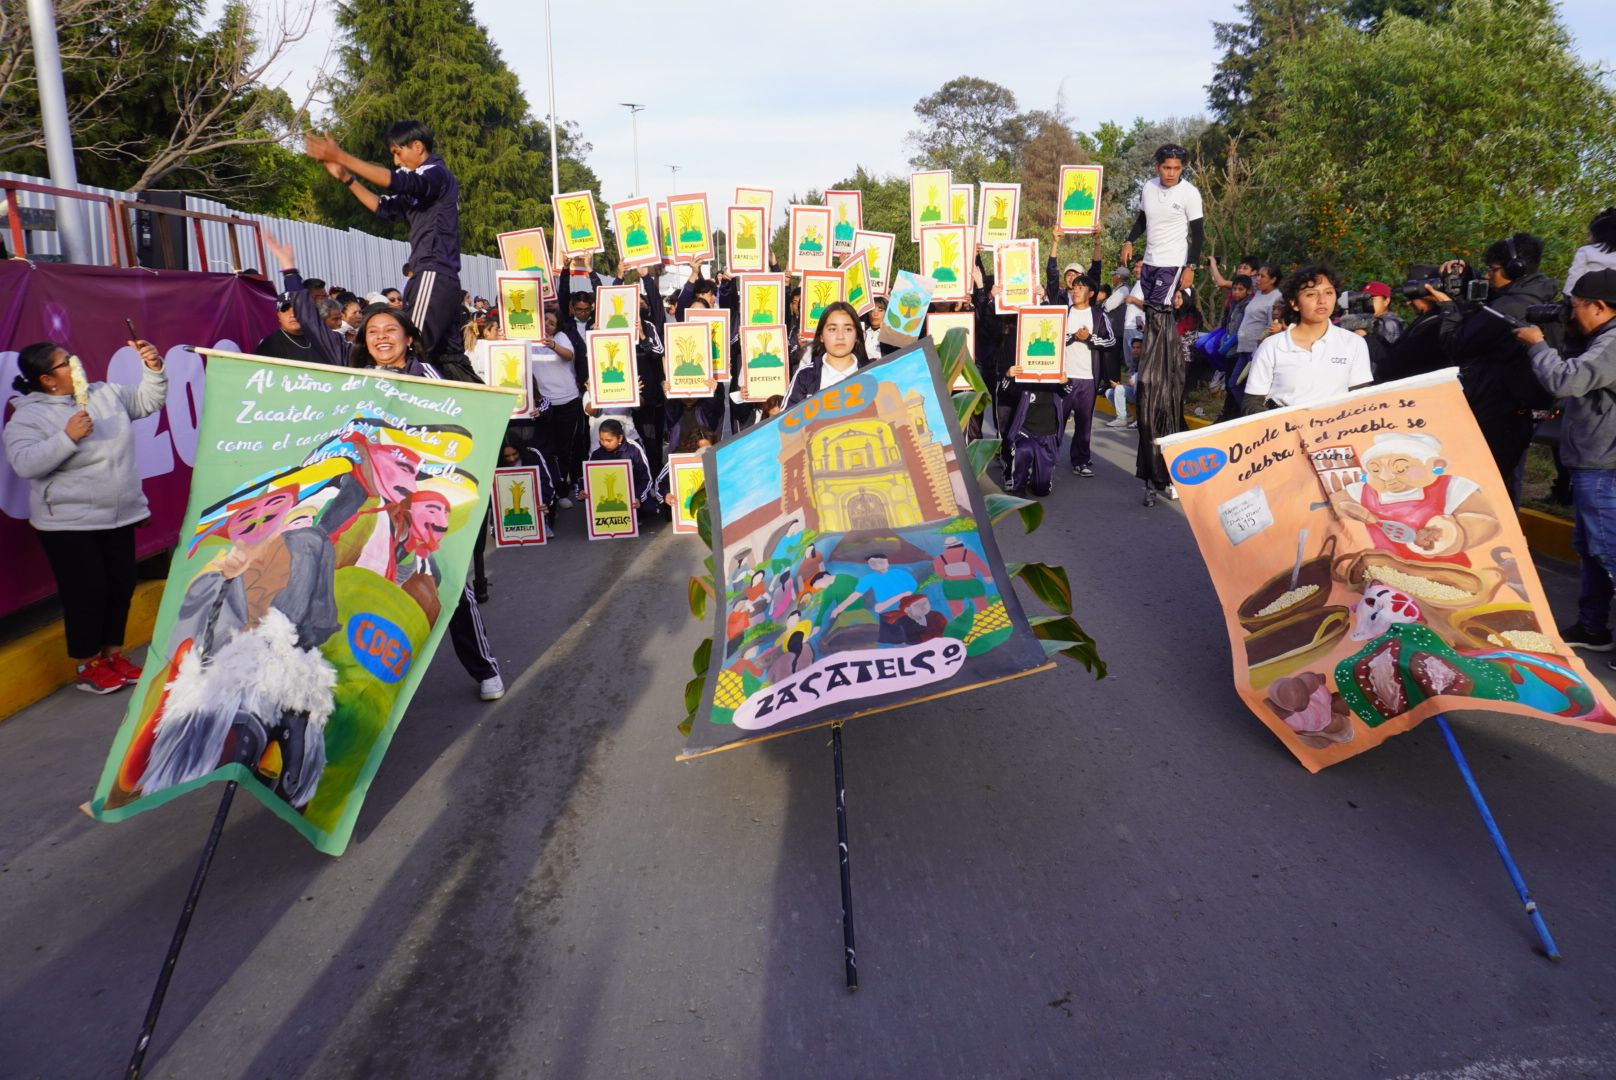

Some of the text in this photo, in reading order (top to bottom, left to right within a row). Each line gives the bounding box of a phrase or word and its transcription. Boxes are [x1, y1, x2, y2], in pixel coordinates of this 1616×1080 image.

[245, 369, 275, 394] Al
[281, 373, 333, 392] ritmo
[341, 375, 368, 391] del
[784, 383, 865, 428] CDEZ
[216, 440, 263, 452] como
[272, 433, 291, 449] el
[236, 400, 325, 424] Zacatelco
[332, 404, 349, 416] se
[445, 441, 459, 458] y
[1229, 399, 1416, 463] Donde la tradición se
[1238, 448, 1295, 481] celebra
[1315, 431, 1328, 443] el
[1337, 418, 1398, 440] pueblo
[1407, 418, 1427, 428] se
[1176, 453, 1220, 478] CDEZ
[354, 620, 411, 676] CDEZ
